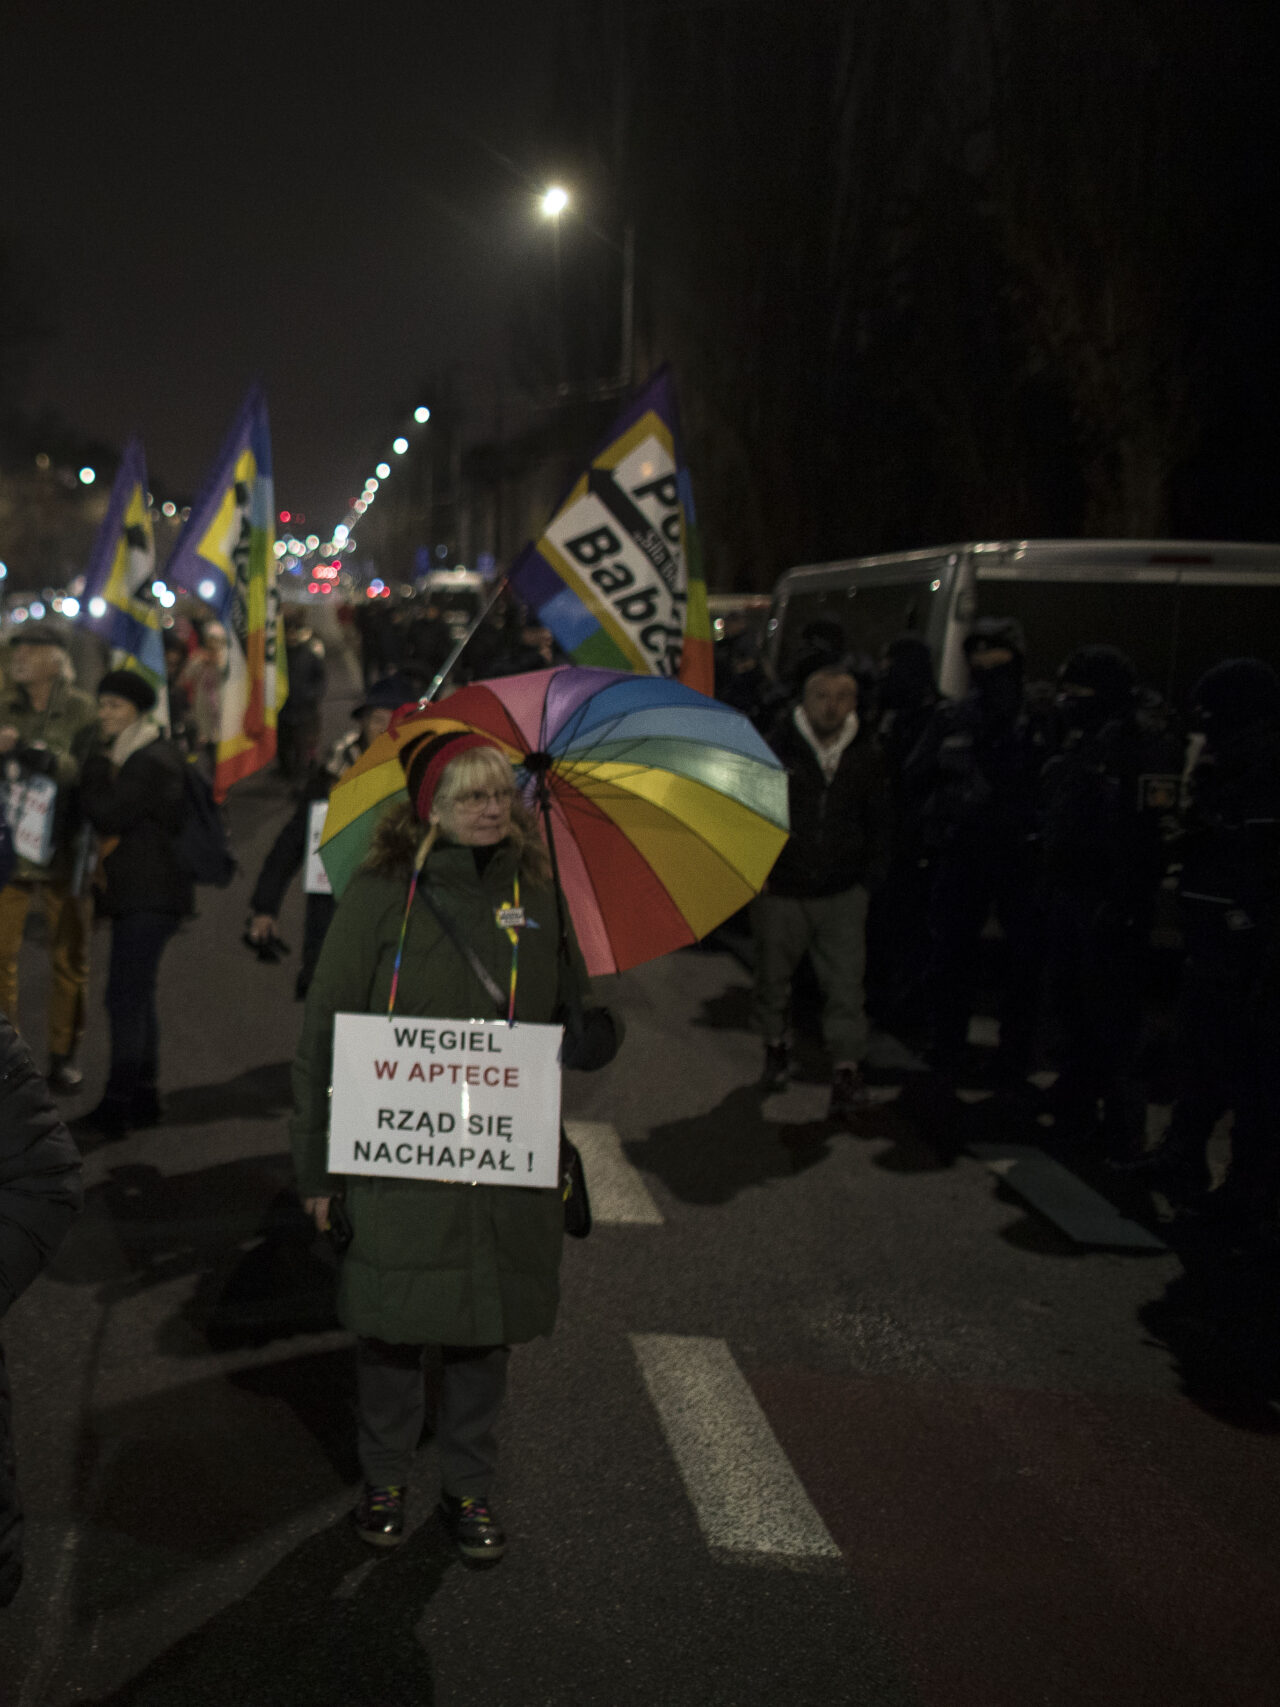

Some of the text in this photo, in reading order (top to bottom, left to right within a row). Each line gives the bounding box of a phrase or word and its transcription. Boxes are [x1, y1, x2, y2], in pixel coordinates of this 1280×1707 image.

[394, 1027, 502, 1054] WĘGIEL
[374, 1060, 520, 1088] W APTECE
[378, 1109, 513, 1142] RZĄD SIĘ
[353, 1141, 515, 1172] NACHAPAŁ
